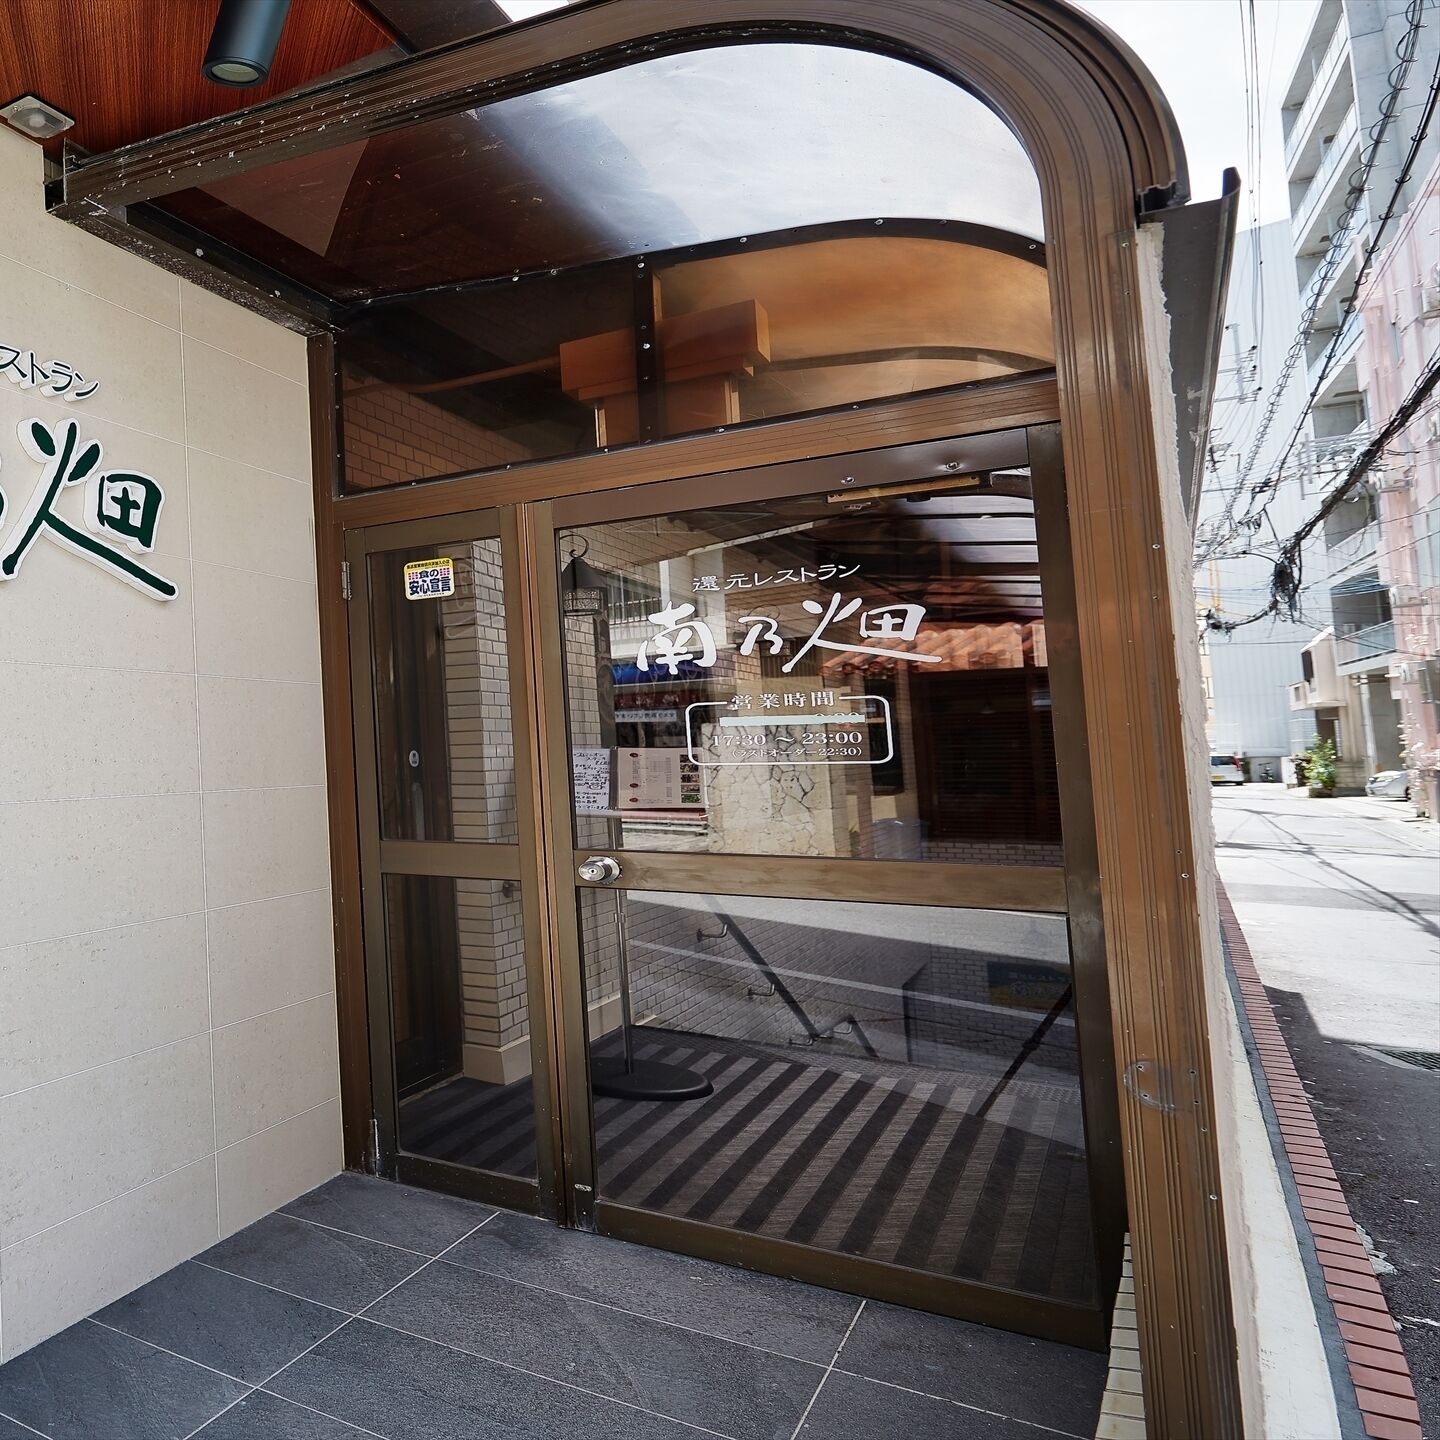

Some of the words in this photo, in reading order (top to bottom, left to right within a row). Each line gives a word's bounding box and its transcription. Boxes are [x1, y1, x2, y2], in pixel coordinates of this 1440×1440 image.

[418, 568, 439, 579] 食の
[692, 564, 861, 593] 還元レストラン
[408, 576, 452, 596] 安心宣言
[636, 592, 943, 675] 南乃畑
[731, 690, 835, 711] 営業時間
[712, 734, 766, 747] 17:30
[801, 731, 863, 746] 23:00
